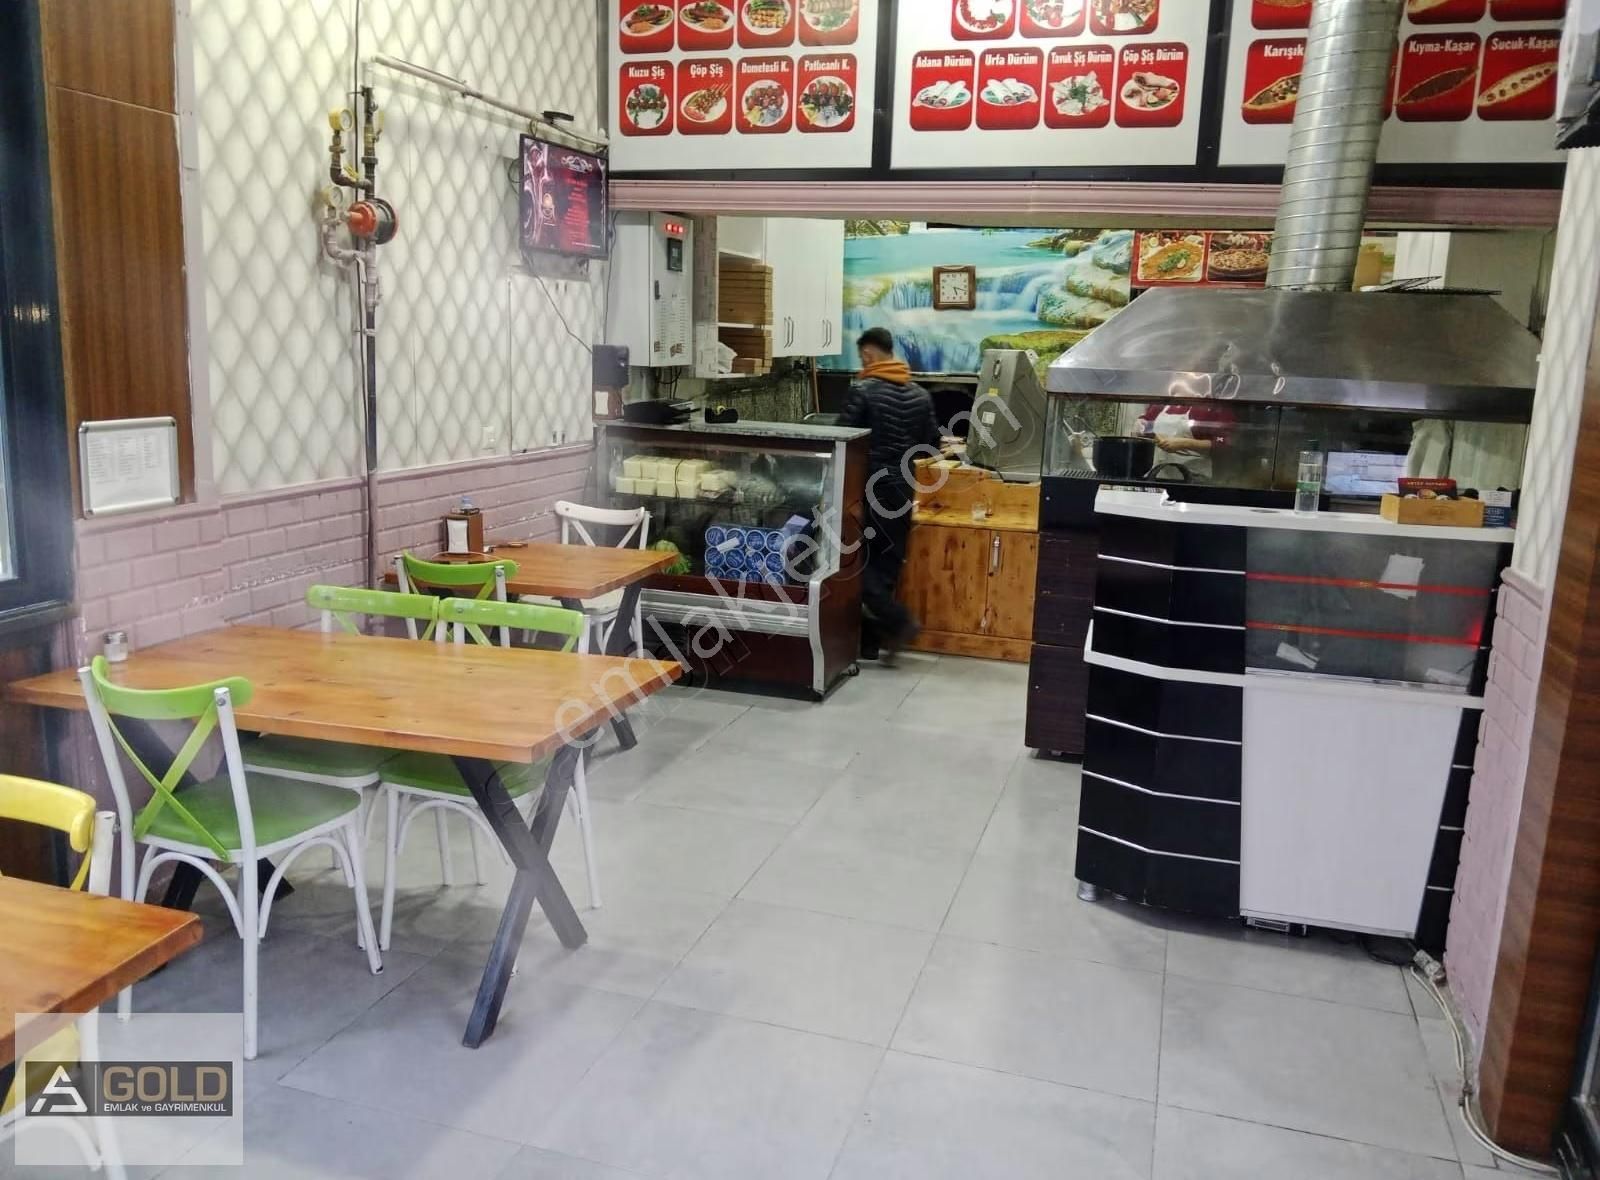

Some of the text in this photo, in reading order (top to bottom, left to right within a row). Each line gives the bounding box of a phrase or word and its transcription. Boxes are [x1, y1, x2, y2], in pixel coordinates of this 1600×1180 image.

[1264, 44, 1304, 60] Karışık
[1409, 40, 1475, 55] Kıyma-Kaşar
[841, 58, 850, 70] K.
[916, 55, 972, 68] Adana Dürüm
[985, 52, 1038, 66] Urfa Dürüm
[1051, 50, 1112, 67] Tavuk Şiş Dürüm
[1123, 48, 1184, 66] Çöp Şiş Dürüm
[628, 65, 665, 80] Kuzu Şiş
[690, 63, 724, 79] Çöp Şiş
